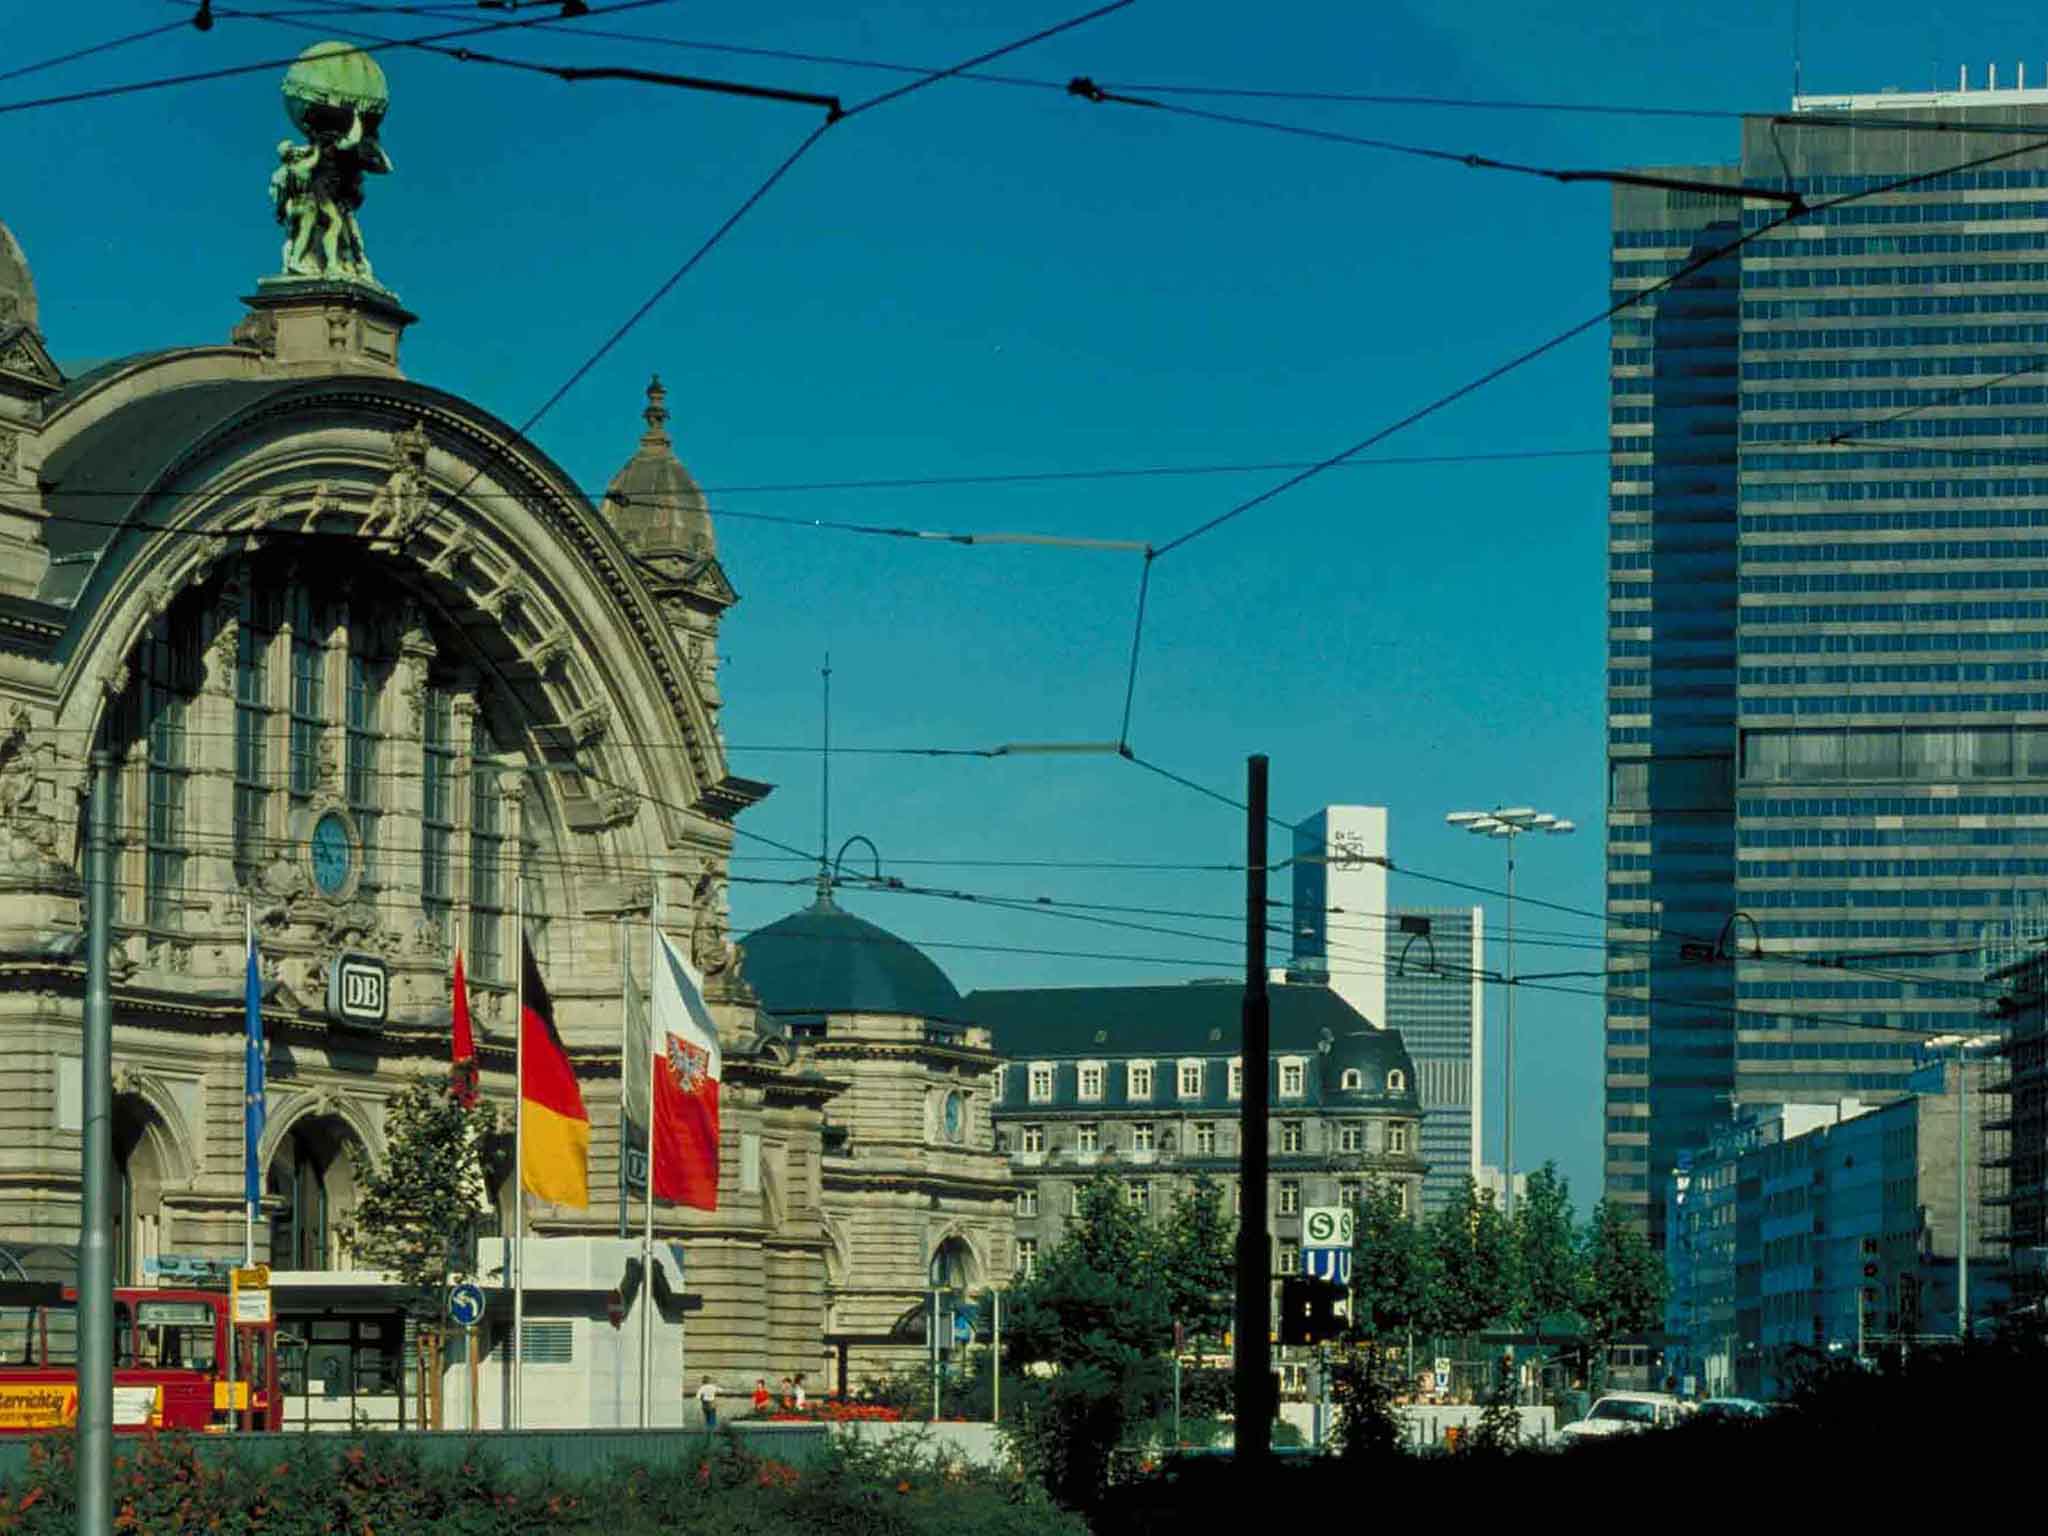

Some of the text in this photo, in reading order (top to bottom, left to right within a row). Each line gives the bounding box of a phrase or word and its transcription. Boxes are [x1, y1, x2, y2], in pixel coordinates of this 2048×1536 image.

[347, 975, 379, 1007] DB
[1311, 1214, 1333, 1240] S
[1341, 1213, 1352, 1241] S
[1307, 1250, 1336, 1281] U
[1340, 1250, 1352, 1285] U
